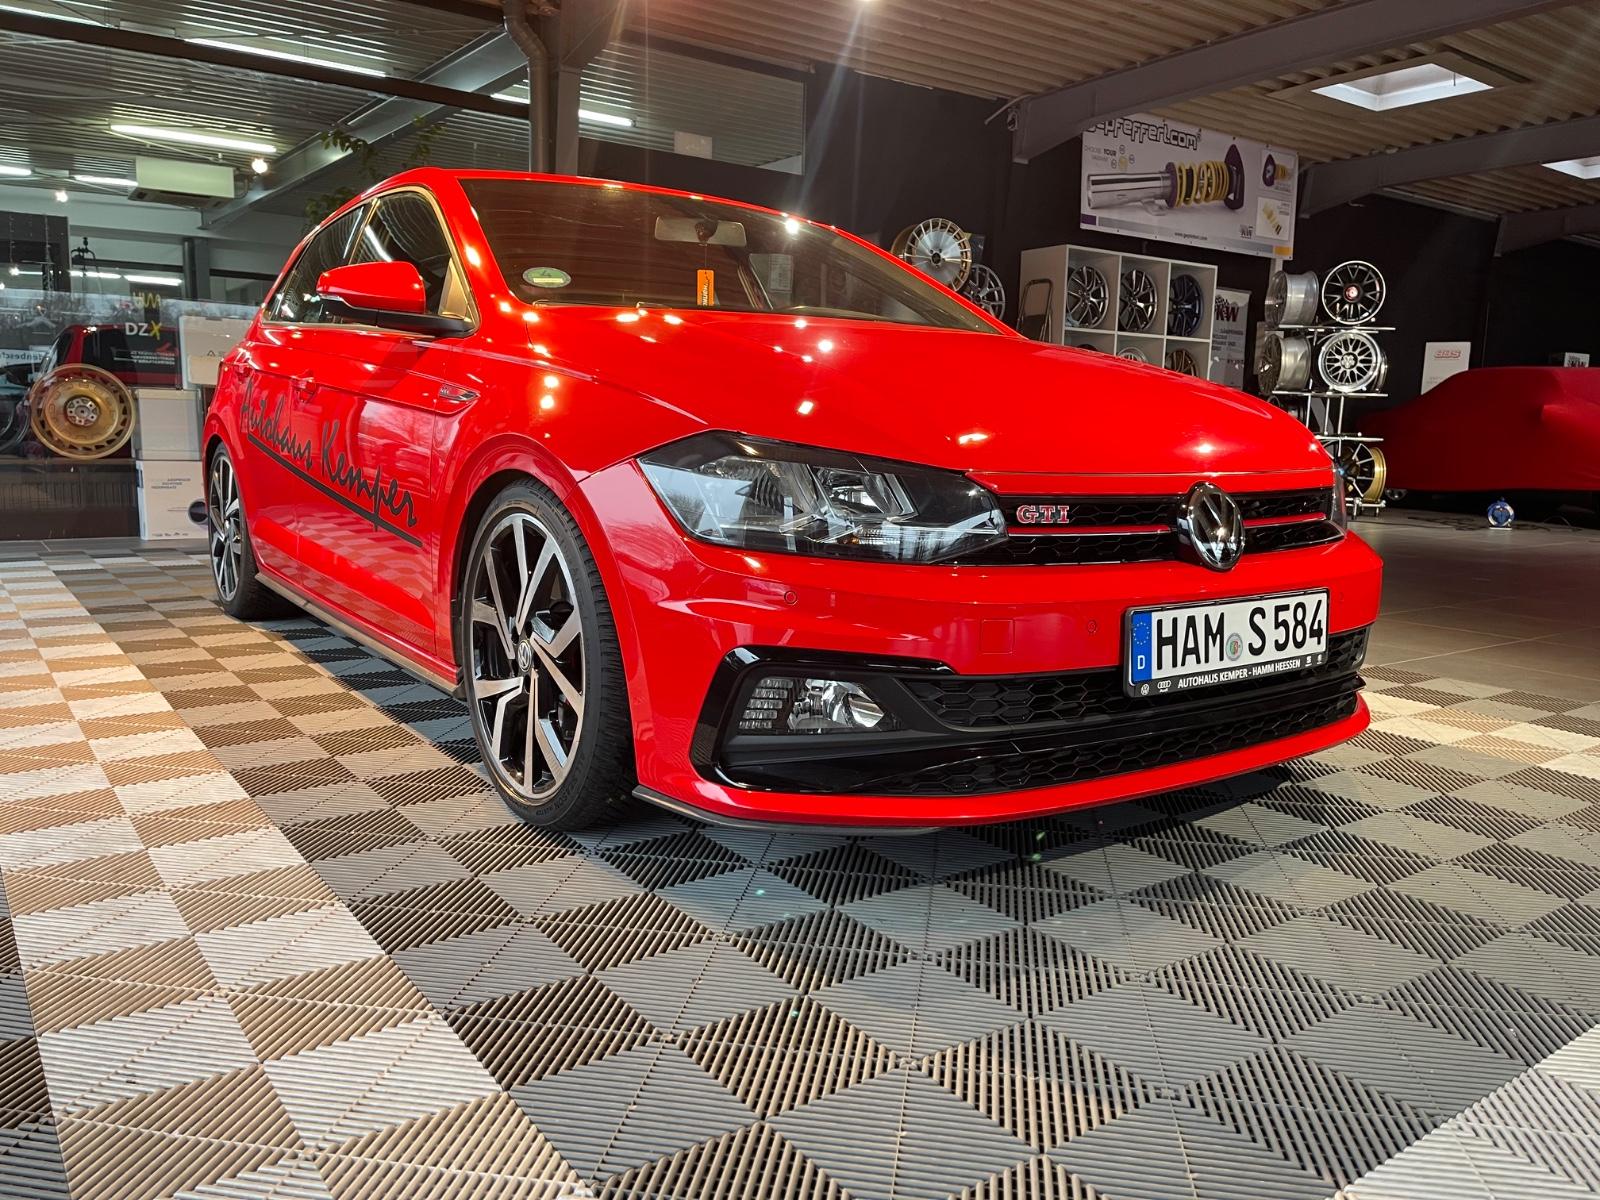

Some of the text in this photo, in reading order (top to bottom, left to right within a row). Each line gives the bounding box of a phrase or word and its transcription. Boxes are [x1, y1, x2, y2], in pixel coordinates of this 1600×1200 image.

[1103, 148, 1117, 157] YOUR
[240, 377, 314, 470] Autohaus
[321, 418, 418, 532] Kemper
[1015, 504, 1070, 524] GTI
[1137, 655, 1146, 670] D
[1156, 612, 1225, 670] HAM
[1177, 673, 1219, 689] AUTOHAUS
[1219, 667, 1248, 682] KEMPER
[1252, 663, 1275, 676] HAMM
[1274, 658, 1301, 671] HEESSEN
